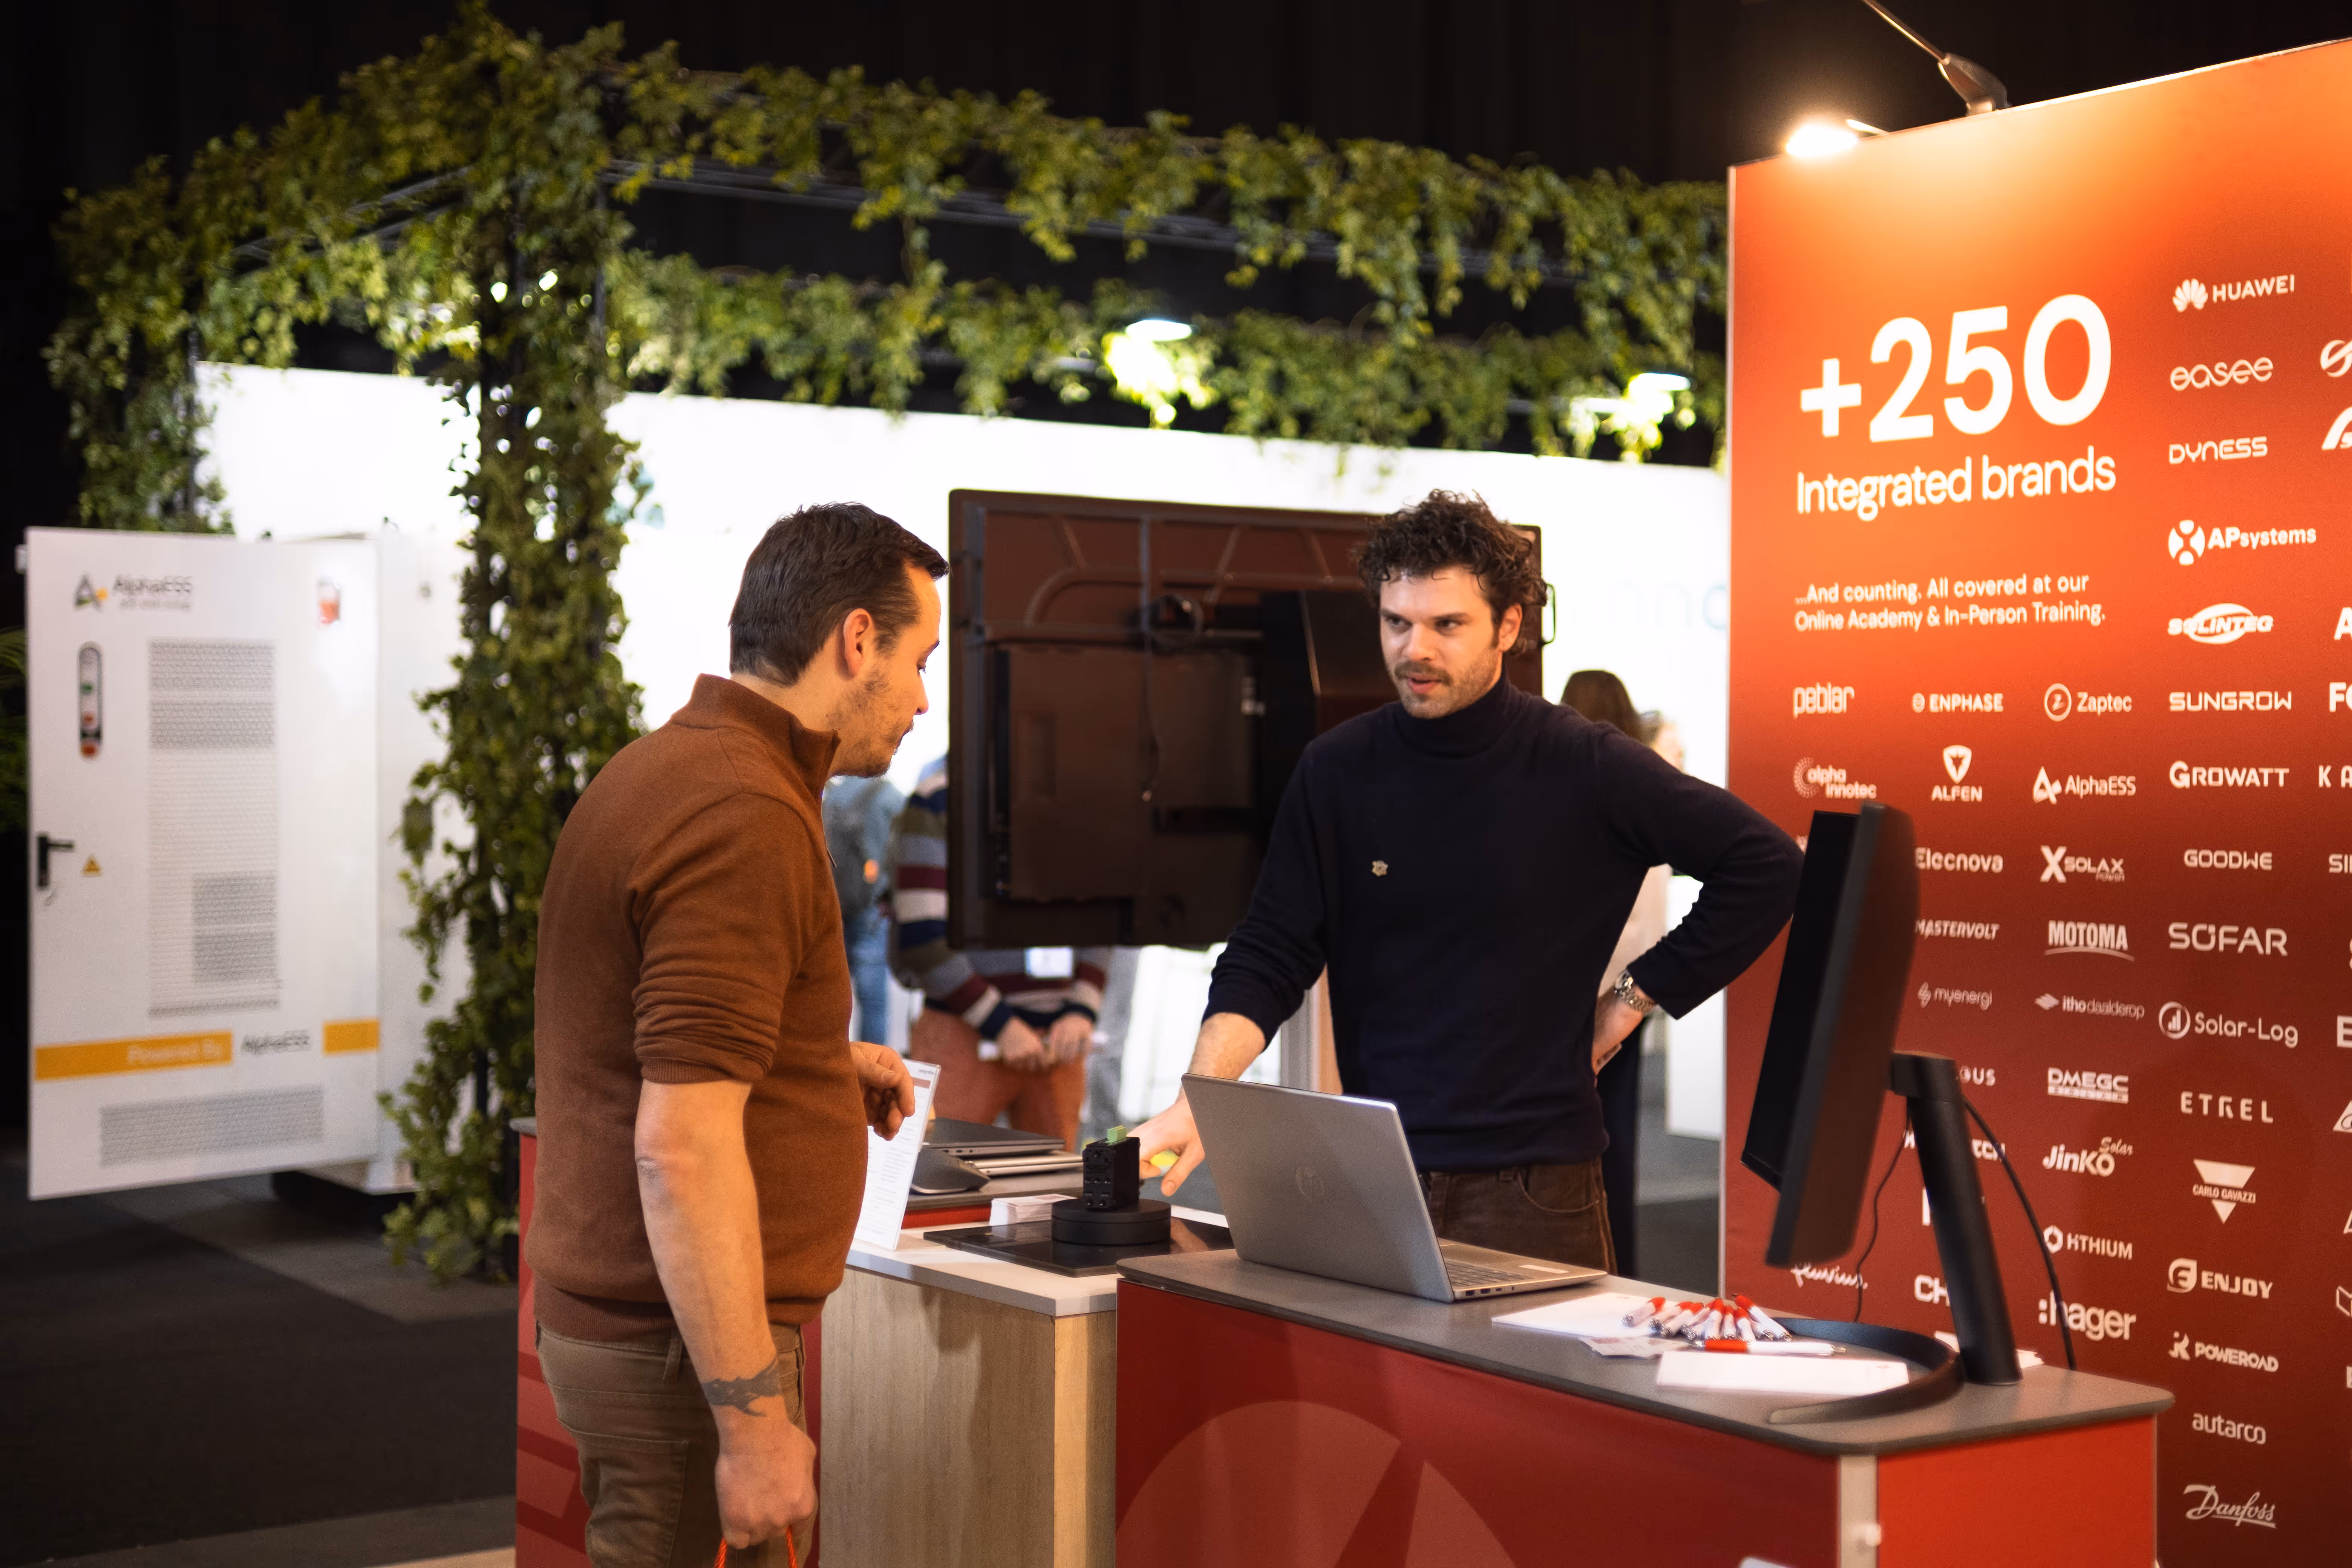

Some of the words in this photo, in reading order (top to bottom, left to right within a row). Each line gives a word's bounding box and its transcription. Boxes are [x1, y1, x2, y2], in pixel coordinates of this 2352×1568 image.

[2213, 274, 2295, 302] HUAWEI
[1801, 294, 2112, 443] +250
[2170, 357, 2274, 391] easee
[2169, 436, 2268, 464] DYNESS
[1797, 456, 1972, 521] Integrated
[1981, 445, 2116, 500] brands
[2208, 527, 2317, 550] APsystems
[1843, 579, 1922, 605] counting.
[1926, 576, 1948, 599] All
[1954, 573, 2027, 598] covered
[2033, 574, 2051, 594] at
[2057, 574, 2089, 593] our
[1795, 609, 1844, 631] Online
[1848, 607, 1922, 632] Academy
[1927, 605, 1940, 627] &
[1945, 603, 2027, 626] In-Person
[2032, 599, 2106, 626] Training.
[1793, 682, 1855, 719] peblar
[1929, 693, 2003, 712] ENPHASE
[2077, 692, 2132, 715] Zaptec
[2169, 691, 2292, 711] SUNGROW
[1808, 764, 1847, 786] alpha
[2065, 775, 2136, 798] AlphaESS
[2169, 761, 2289, 789] GROWATT
[1826, 781, 1877, 799] innotec
[1931, 786, 1983, 801] ALFEN
[1916, 847, 2003, 873] Elecnova
[2184, 849, 2272, 870] GOODWE
[2049, 920, 2128, 951] MOTOMA
[2168, 922, 2288, 956] SOFAR
[1934, 987, 1992, 1011] myenergi
[2194, 1012, 2298, 1048] Solar-Log
[2048, 1067, 2129, 1092] DMEGC
[2181, 1091, 2273, 1123] ETREL
[2099, 1136, 2133, 1156] Solar
[2193, 1184, 2219, 1199] CARLO
[2221, 1188, 2256, 1204] GAVAZZI
[2201, 1270, 2273, 1299] ENJOY
[2195, 1342, 2279, 1372] POWEROAD
[2192, 1413, 2266, 1445] autarco
[2184, 1484, 2276, 1528] Danfoss
